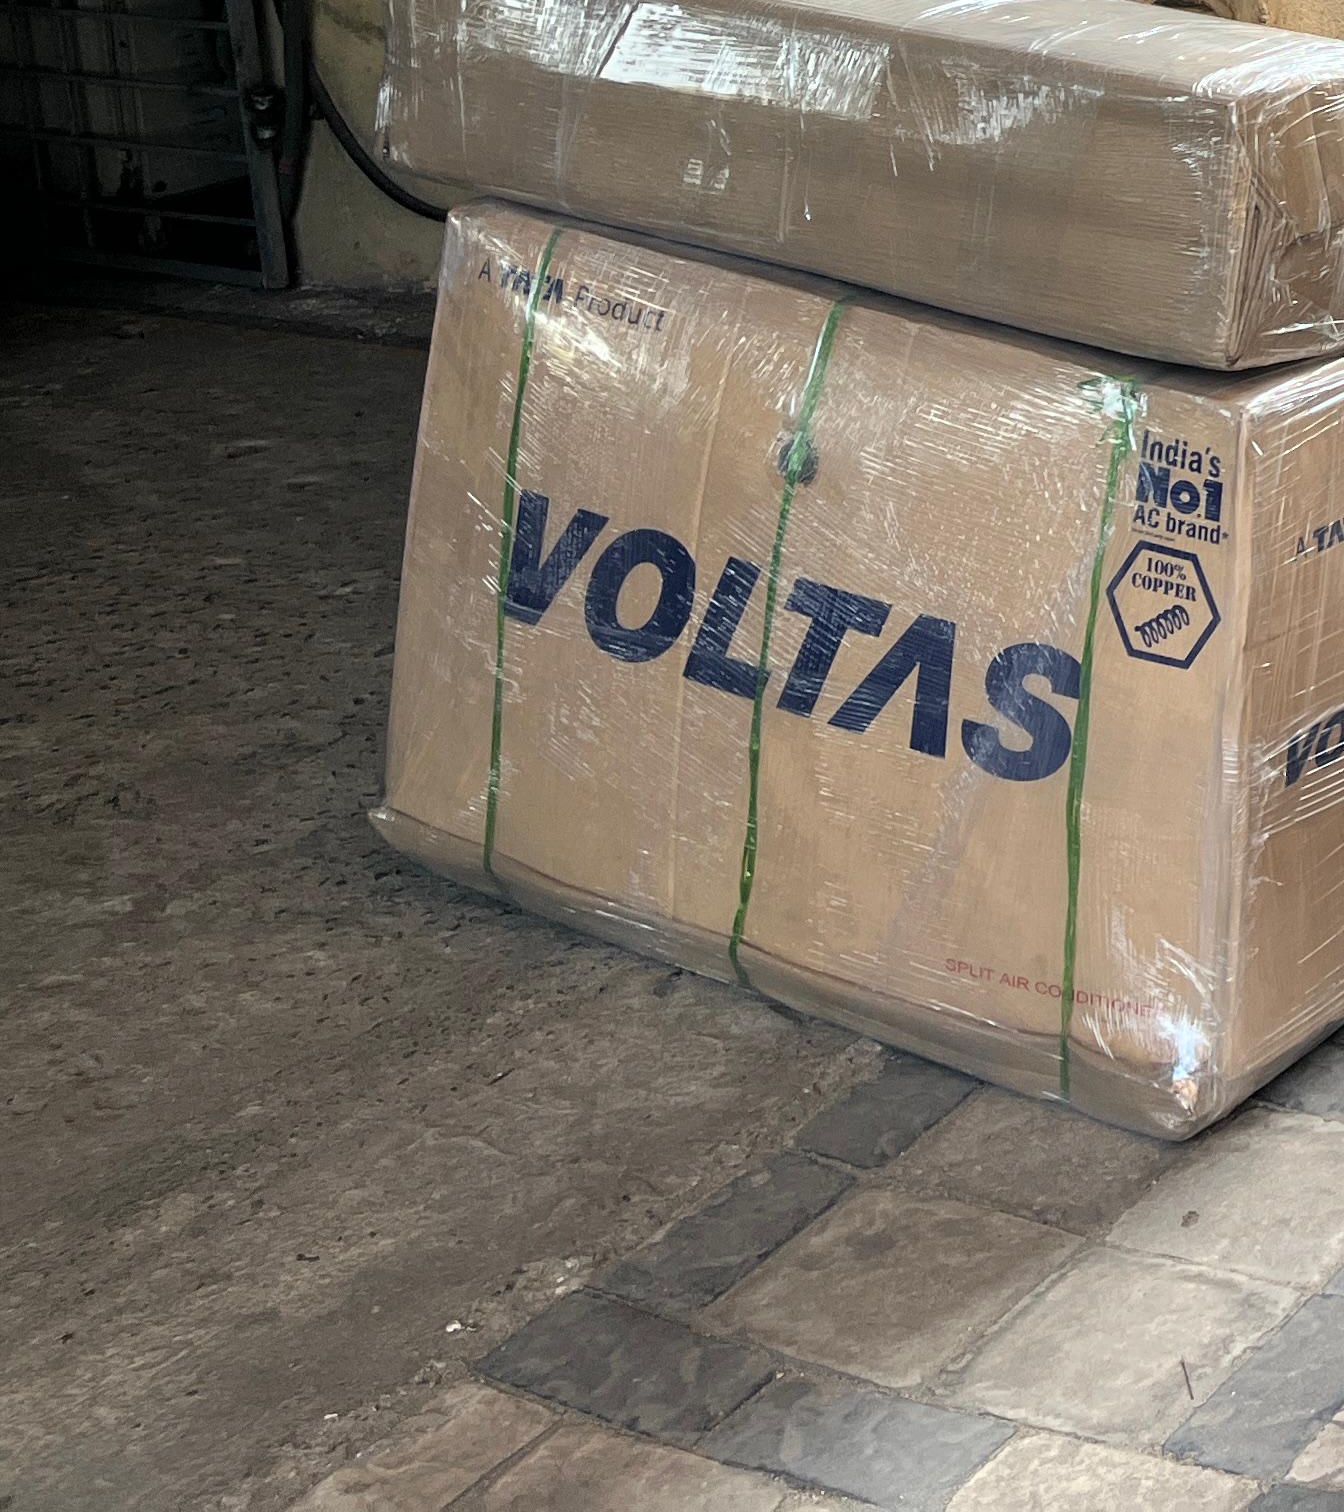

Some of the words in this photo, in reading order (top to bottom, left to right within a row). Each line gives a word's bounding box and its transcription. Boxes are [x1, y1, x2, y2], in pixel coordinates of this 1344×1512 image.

[478, 257, 491, 282] A
[500, 264, 565, 304] TAA
[573, 285, 665, 332] Product
[1141, 430, 1222, 479] India's
[1132, 504, 1160, 529] AC
[1135, 461, 1223, 522] No.1
[1132, 572, 1197, 602] COPPER
[1146, 557, 1187, 581] 100%
[503, 488, 1082, 782] VOLTAS
[945, 957, 995, 982] SPLIT
[1000, 973, 1030, 992] AIR
[1035, 981, 1165, 1019] CODITIONE
